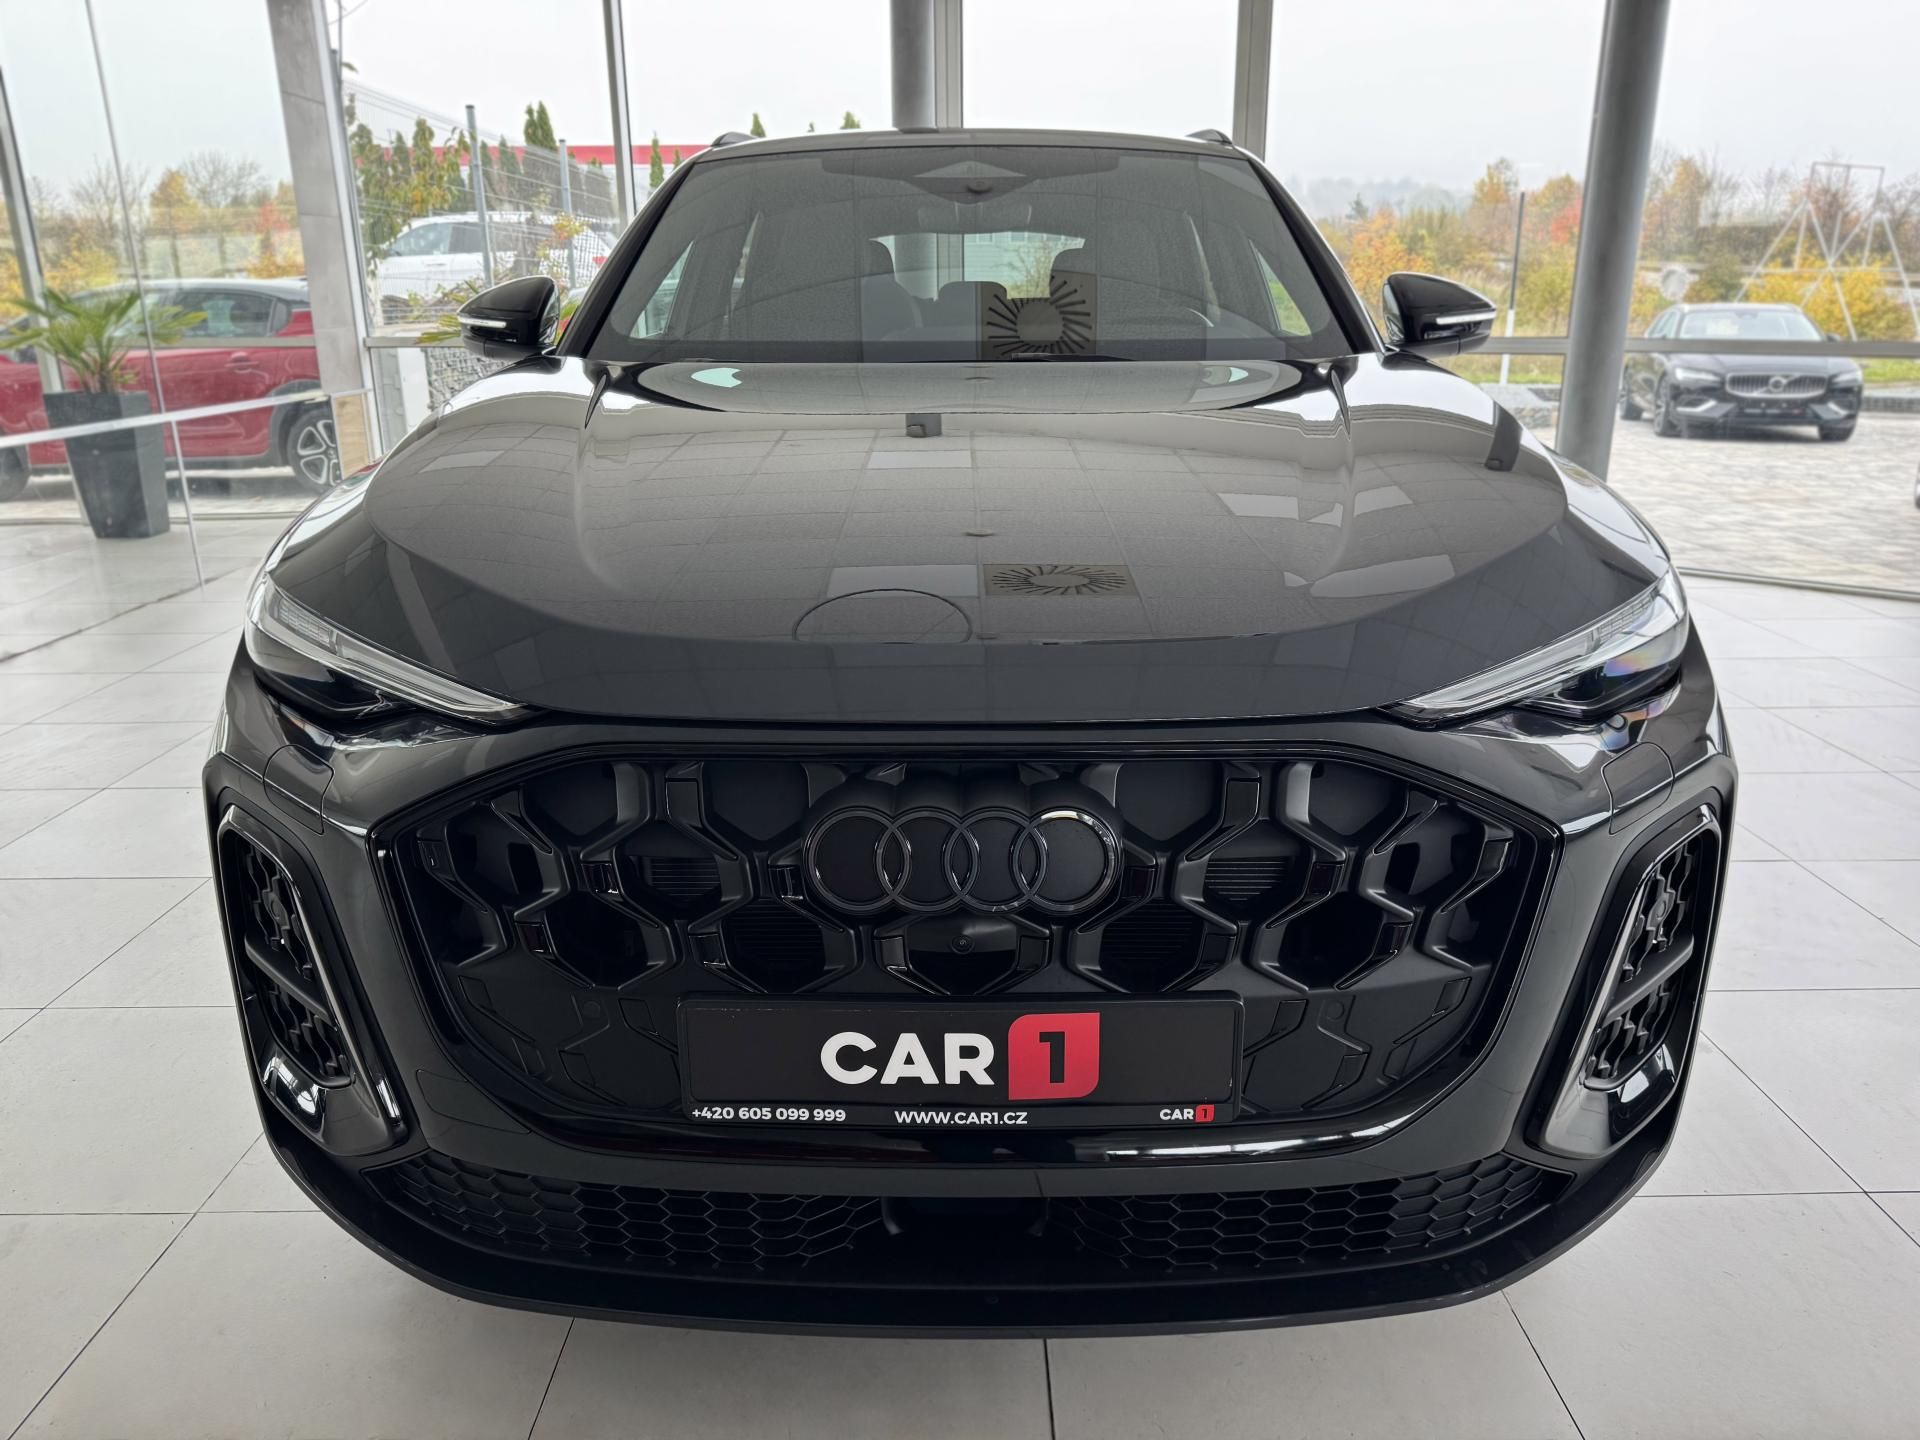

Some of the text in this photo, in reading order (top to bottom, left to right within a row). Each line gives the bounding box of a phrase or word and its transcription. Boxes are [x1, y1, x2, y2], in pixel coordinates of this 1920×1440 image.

[691, 1107, 847, 1122] +420 605 099 999
[894, 1110, 1028, 1125] WWW.CAR1.CZ
